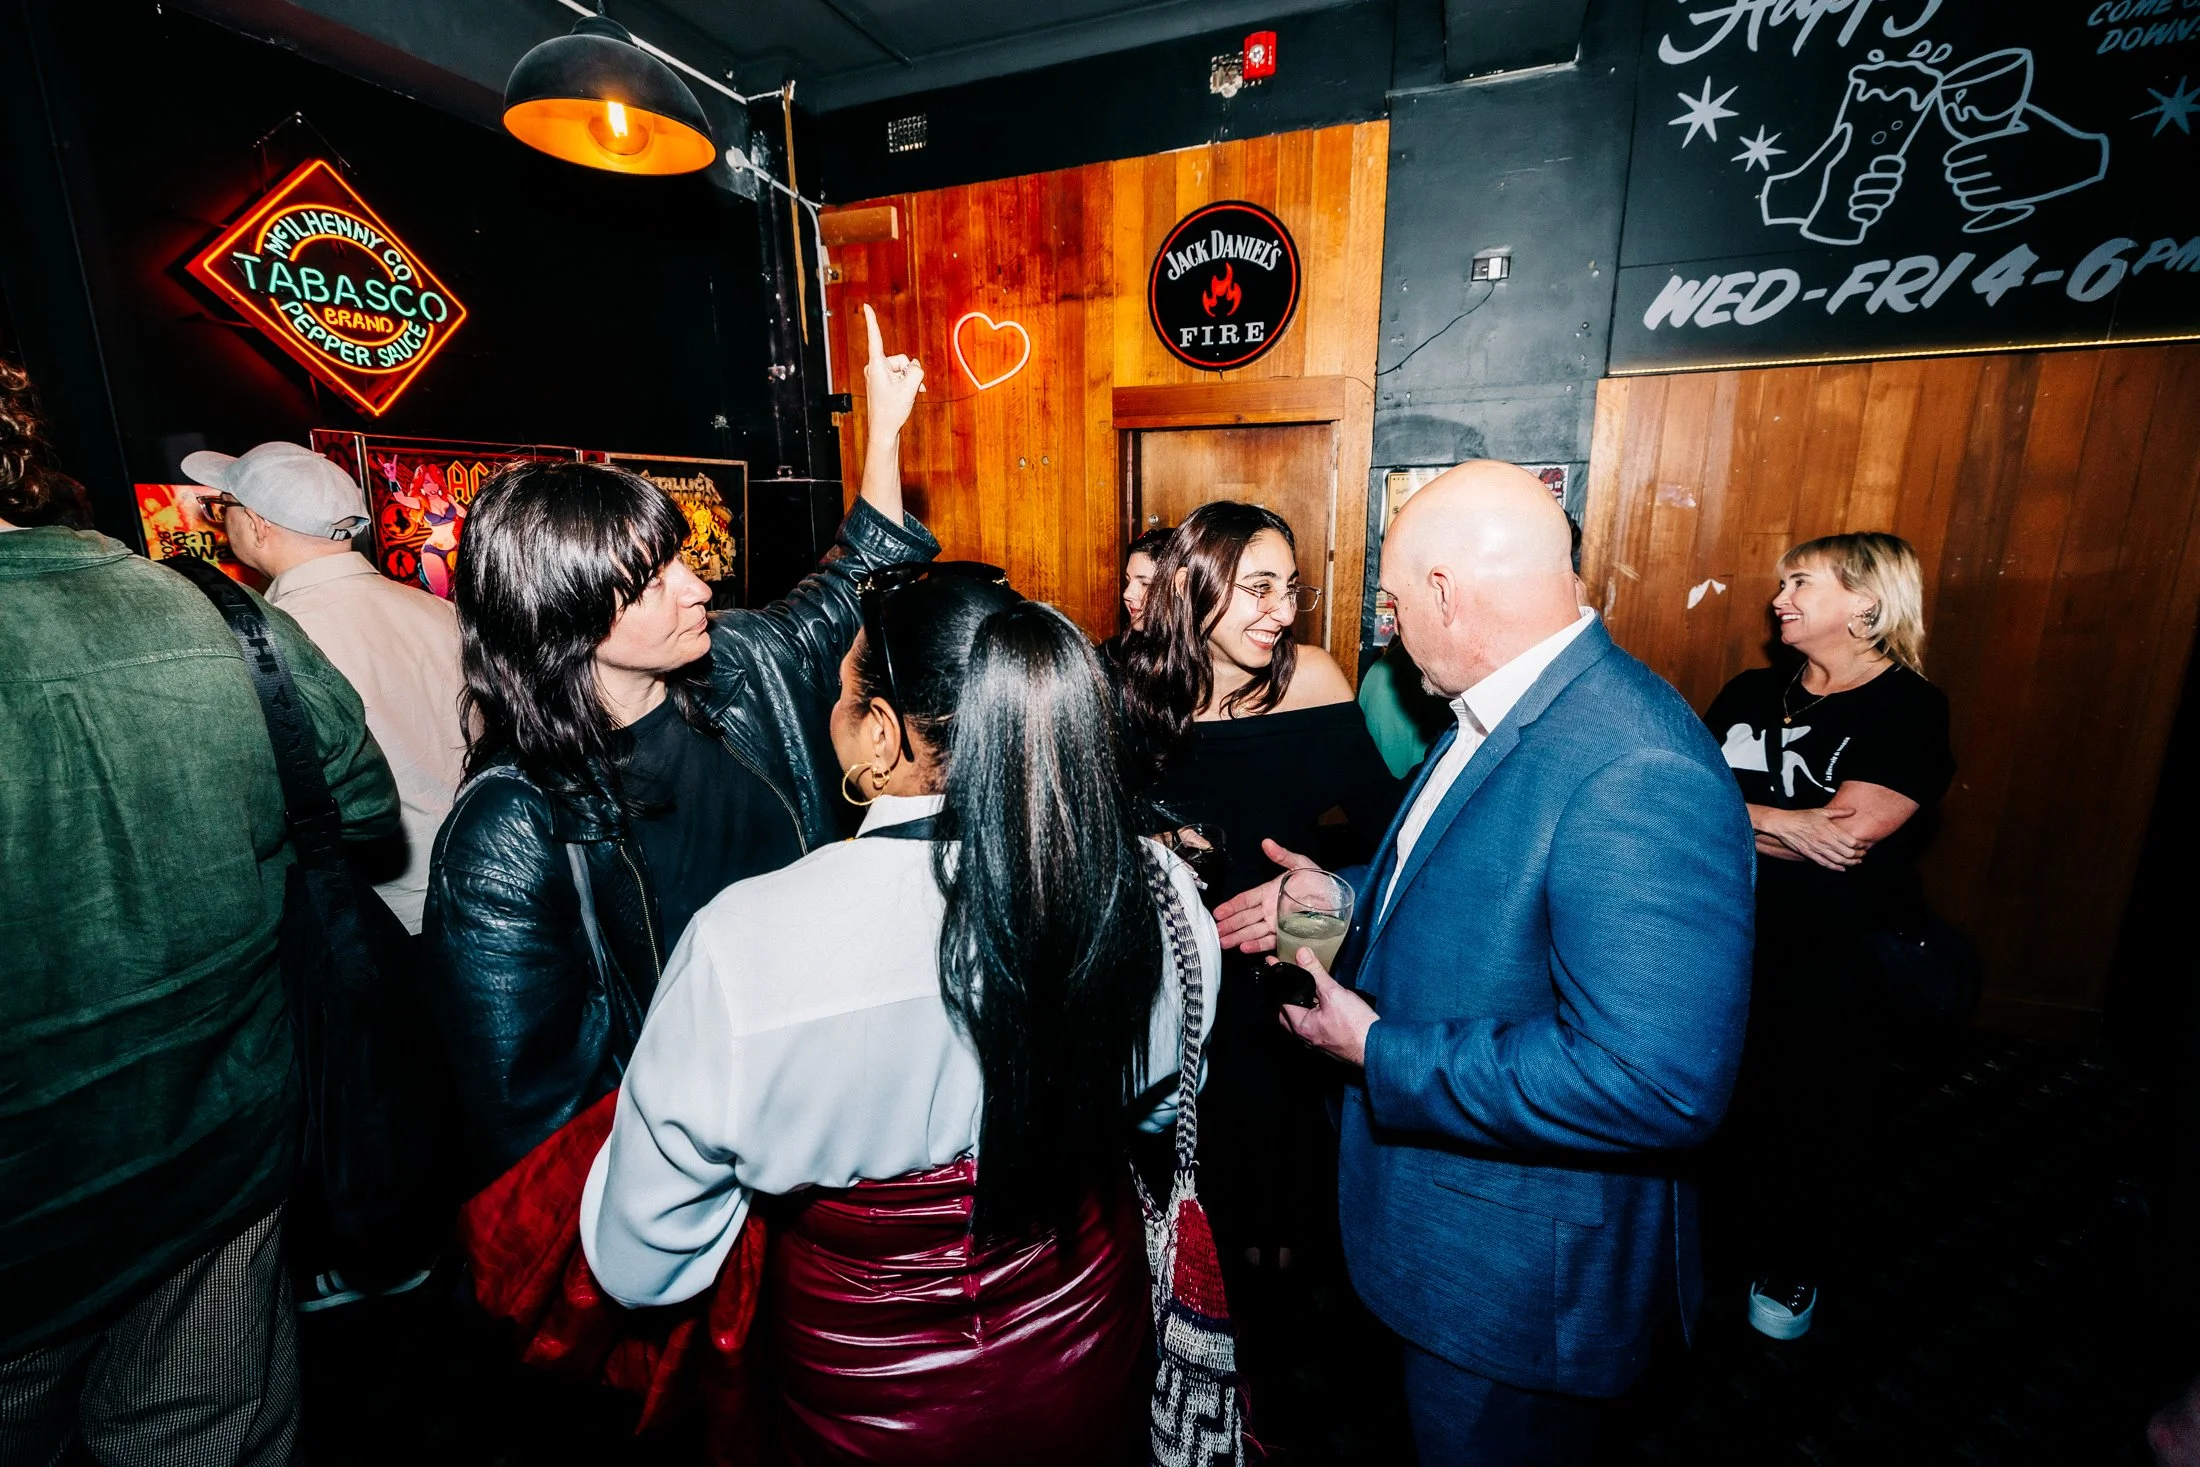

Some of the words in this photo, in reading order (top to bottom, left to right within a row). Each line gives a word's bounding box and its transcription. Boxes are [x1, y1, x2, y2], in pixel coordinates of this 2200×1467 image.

[2086, 0, 2173, 27] COME
[383, 249, 413, 282] CO
[1165, 238, 1211, 281] JACK
[1210, 229, 1283, 272] DANIEL'S
[232, 251, 449, 324] TABASCO
[280, 300, 372, 367] PEPPER
[376, 320, 428, 368] SAUCE
[323, 306, 394, 334] BRAND
[1179, 321, 1266, 348] FIRE
